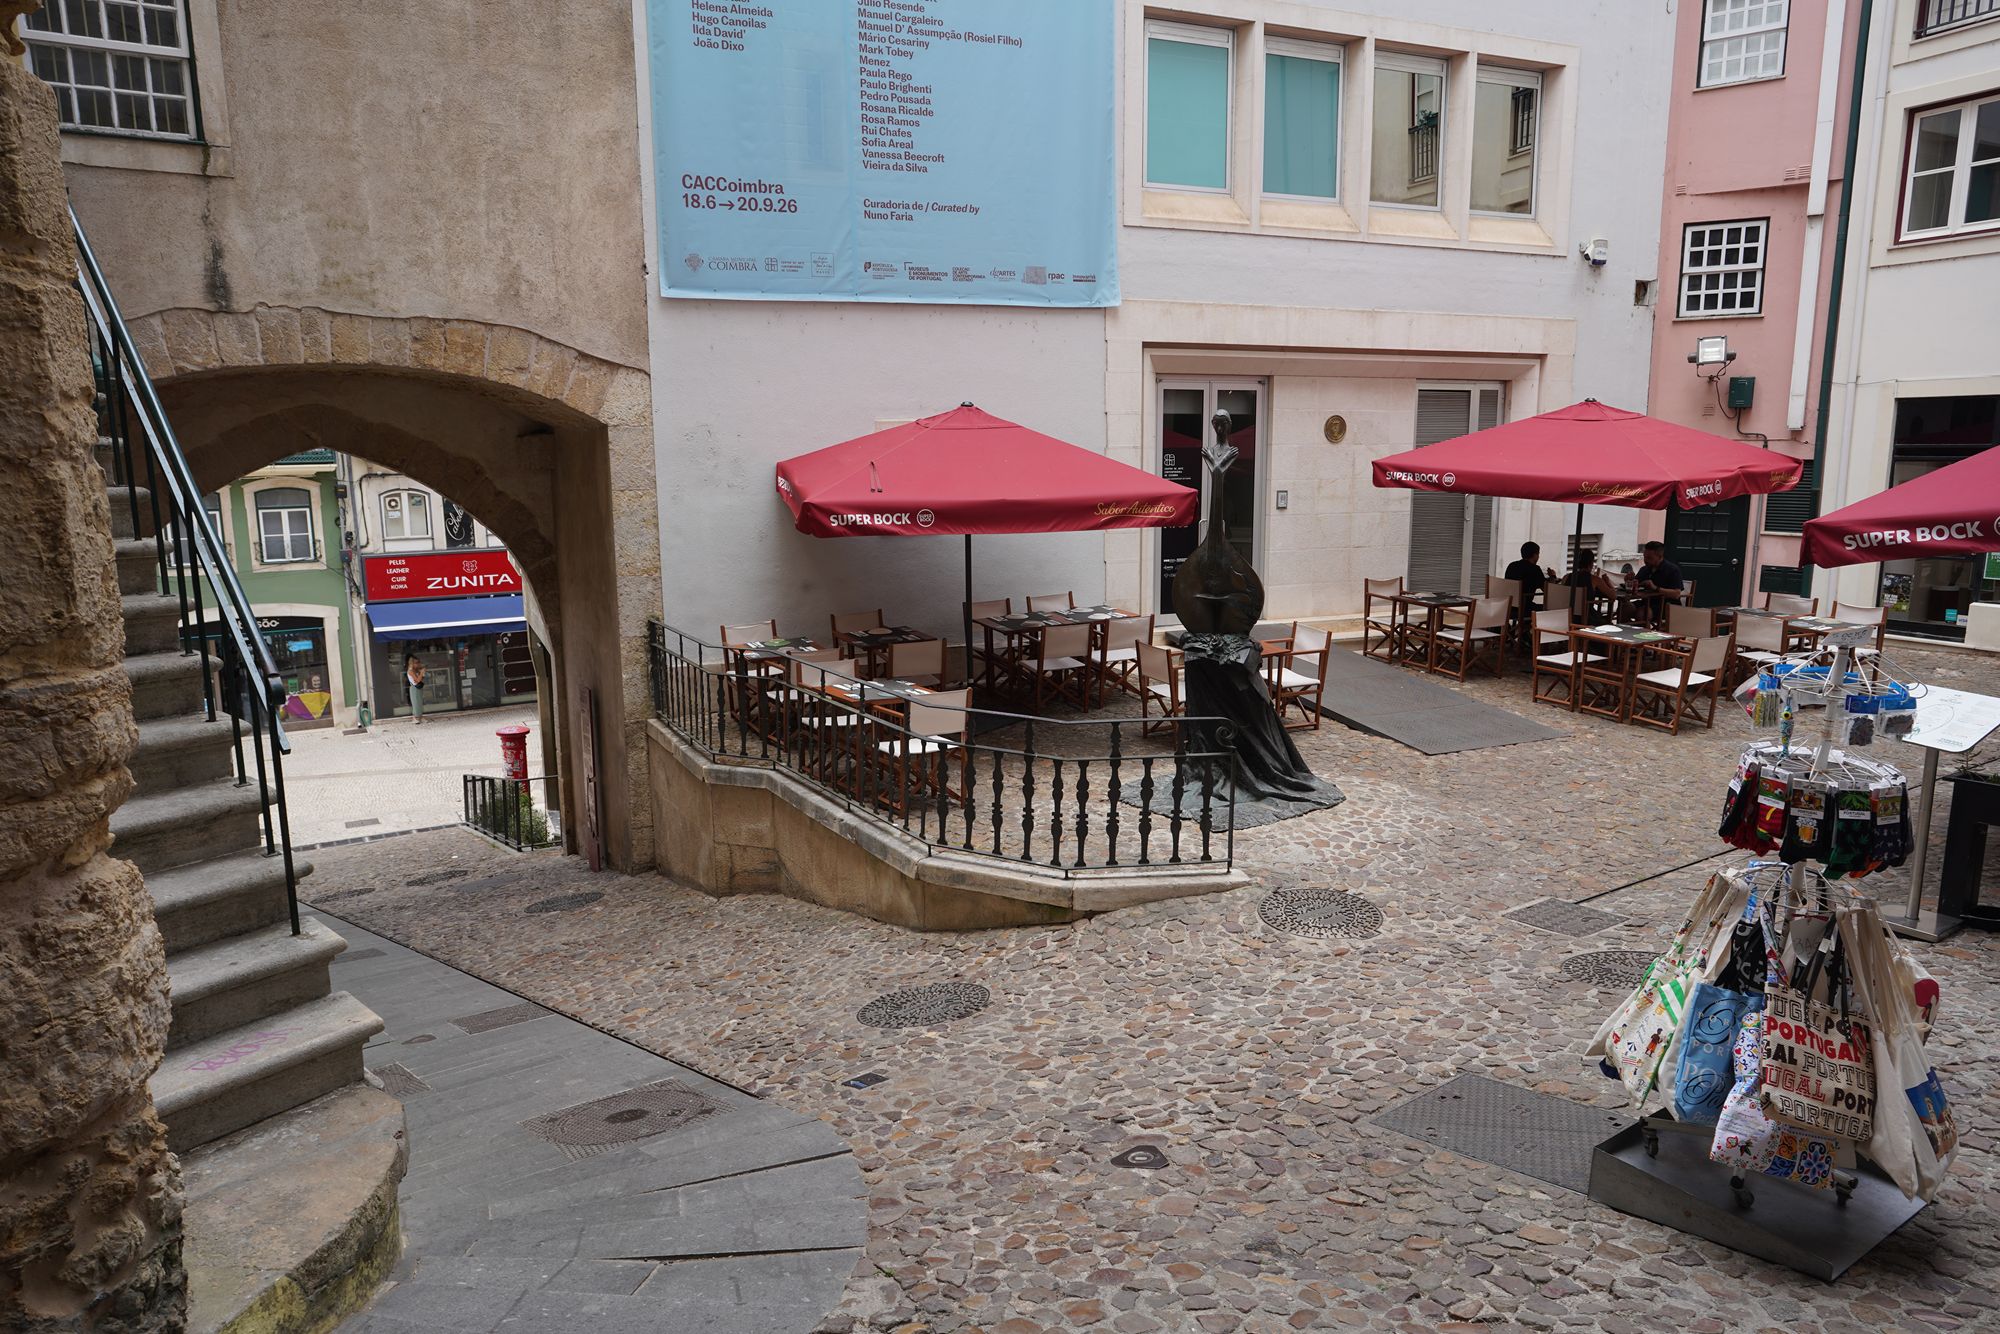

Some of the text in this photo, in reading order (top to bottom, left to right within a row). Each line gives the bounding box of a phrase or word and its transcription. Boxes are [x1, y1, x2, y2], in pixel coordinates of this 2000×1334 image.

[692, 0, 773, 17] Helena Almeida
[884, 0, 925, 12] Resende
[693, 12, 767, 29] Hugo Canoilas
[858, 8, 944, 26] Manuel Cargaleiro
[693, 24, 711, 36] Ilda
[858, 20, 893, 32] Manuel
[906, 26, 962, 40] Assumpção
[964, 32, 995, 44] (Rosiel
[997, 35, 1023, 48] Filho)
[693, 37, 744, 51] João Dixo
[859, 31, 930, 50] Mário Cesariny
[859, 44, 914, 59] Mark Tobey
[860, 55, 890, 67] Menez
[860, 67, 912, 82] Paula Rego
[860, 78, 932, 94] Paulo Brighenti
[860, 90, 931, 105] Pedro Pousada
[861, 102, 934, 117] Rosana Ricalde
[861, 113, 920, 127] Rosa Ramos
[861, 125, 912, 138] Rui Chafes
[861, 137, 914, 149] Sofia Areal
[862, 149, 944, 163] Vanessa Beecroft
[863, 160, 928, 173] Vieira da Silva
[682, 174, 785, 194] CACCoimbra
[863, 198, 910, 210] Curadoria
[912, 201, 924, 211] de
[931, 202, 968, 213] Curated
[969, 204, 980, 215] by
[864, 210, 914, 221] Nuno Faria
[708, 261, 758, 271] COIMBRA
[1386, 471, 1414, 481] SUPER
[1415, 473, 1439, 483] BOCK
[1699, 483, 1714, 496] BOCK
[1094, 502, 1127, 515] Sabor
[830, 512, 911, 526] SUPER BOCK
[1843, 521, 1984, 550] SUPER BOCK
[426, 573, 514, 590] ZUNITA
